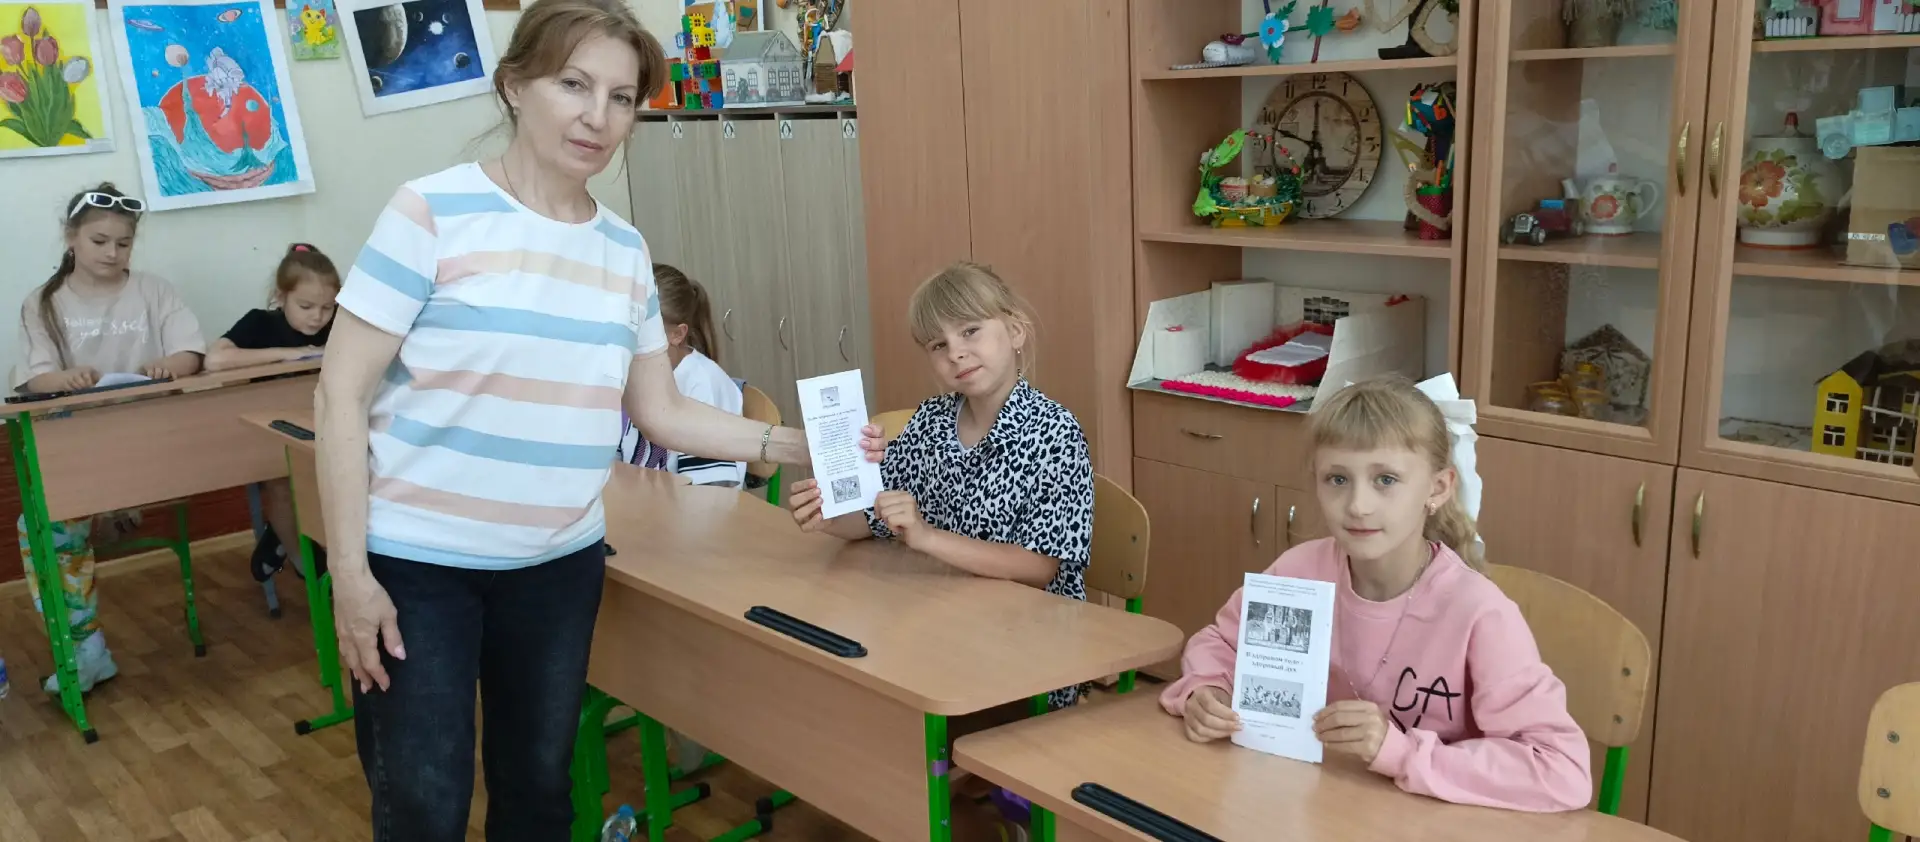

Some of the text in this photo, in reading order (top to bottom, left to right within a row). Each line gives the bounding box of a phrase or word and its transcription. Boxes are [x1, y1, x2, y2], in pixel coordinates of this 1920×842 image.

[1285, 82, 1295, 99] 11
[1312, 74, 1327, 90] 12
[1263, 109, 1277, 126] 10
